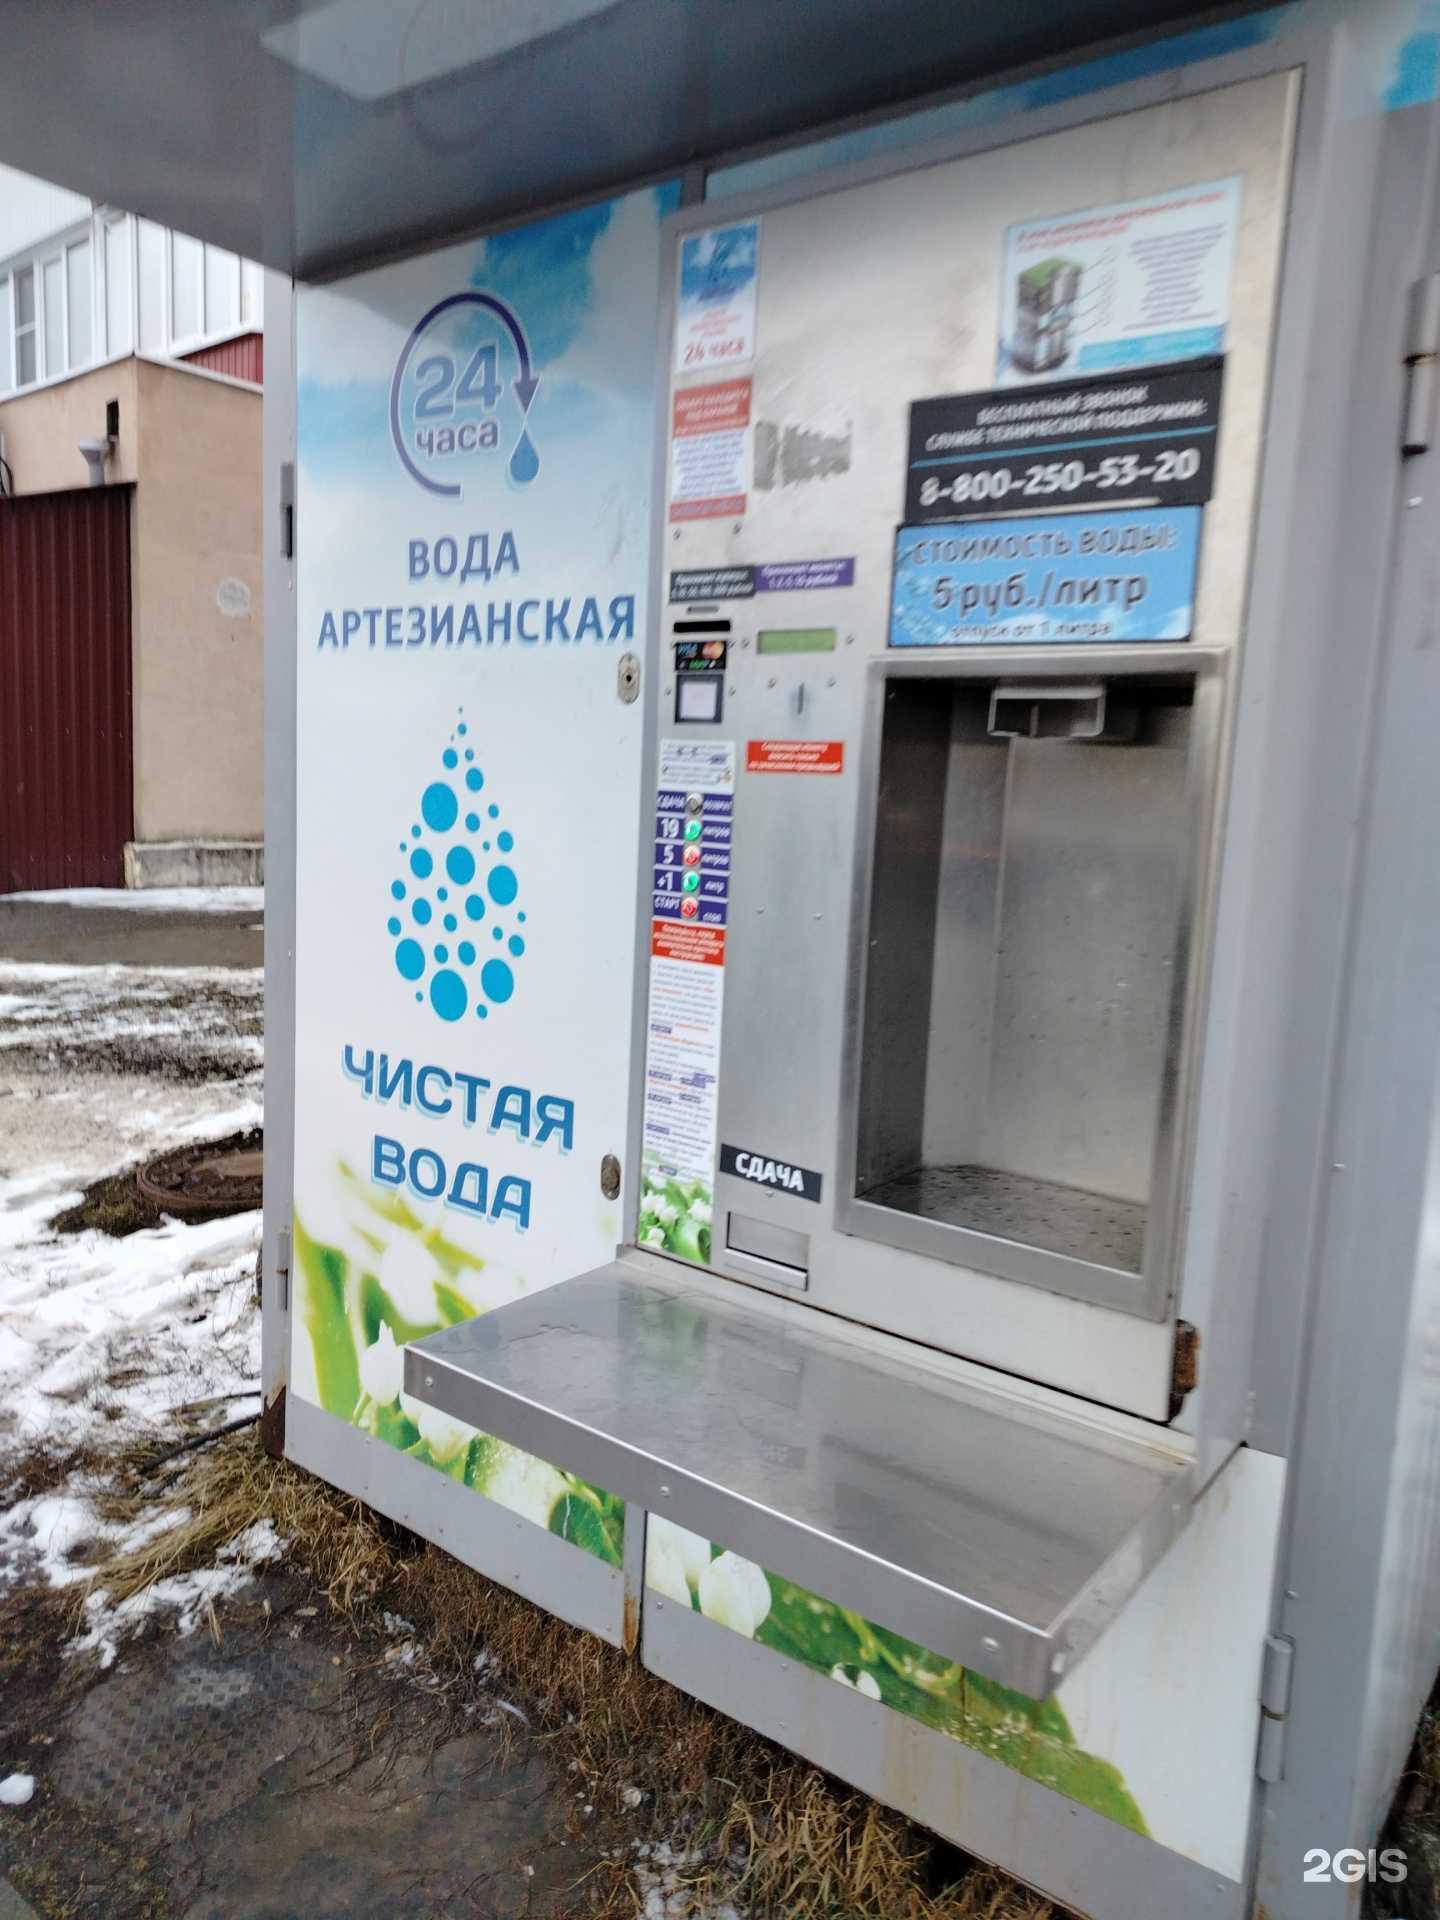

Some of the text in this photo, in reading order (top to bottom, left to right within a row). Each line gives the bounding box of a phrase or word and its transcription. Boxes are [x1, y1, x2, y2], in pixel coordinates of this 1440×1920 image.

[415, 346, 503, 418] 24
[416, 422, 499, 457] часа
[919, 448, 1201, 506] 8-800-250-53-20
[408, 531, 520, 586] ВОДА
[317, 594, 637, 650] АРТЕЗИАНСКАЯ
[661, 818, 680, 838] 19
[662, 845, 675, 865] 5
[342, 1044, 575, 1153] ЧИСТАЯ
[372, 1134, 532, 1231] ВОДА
[735, 1153, 805, 1192] СДАЧА
